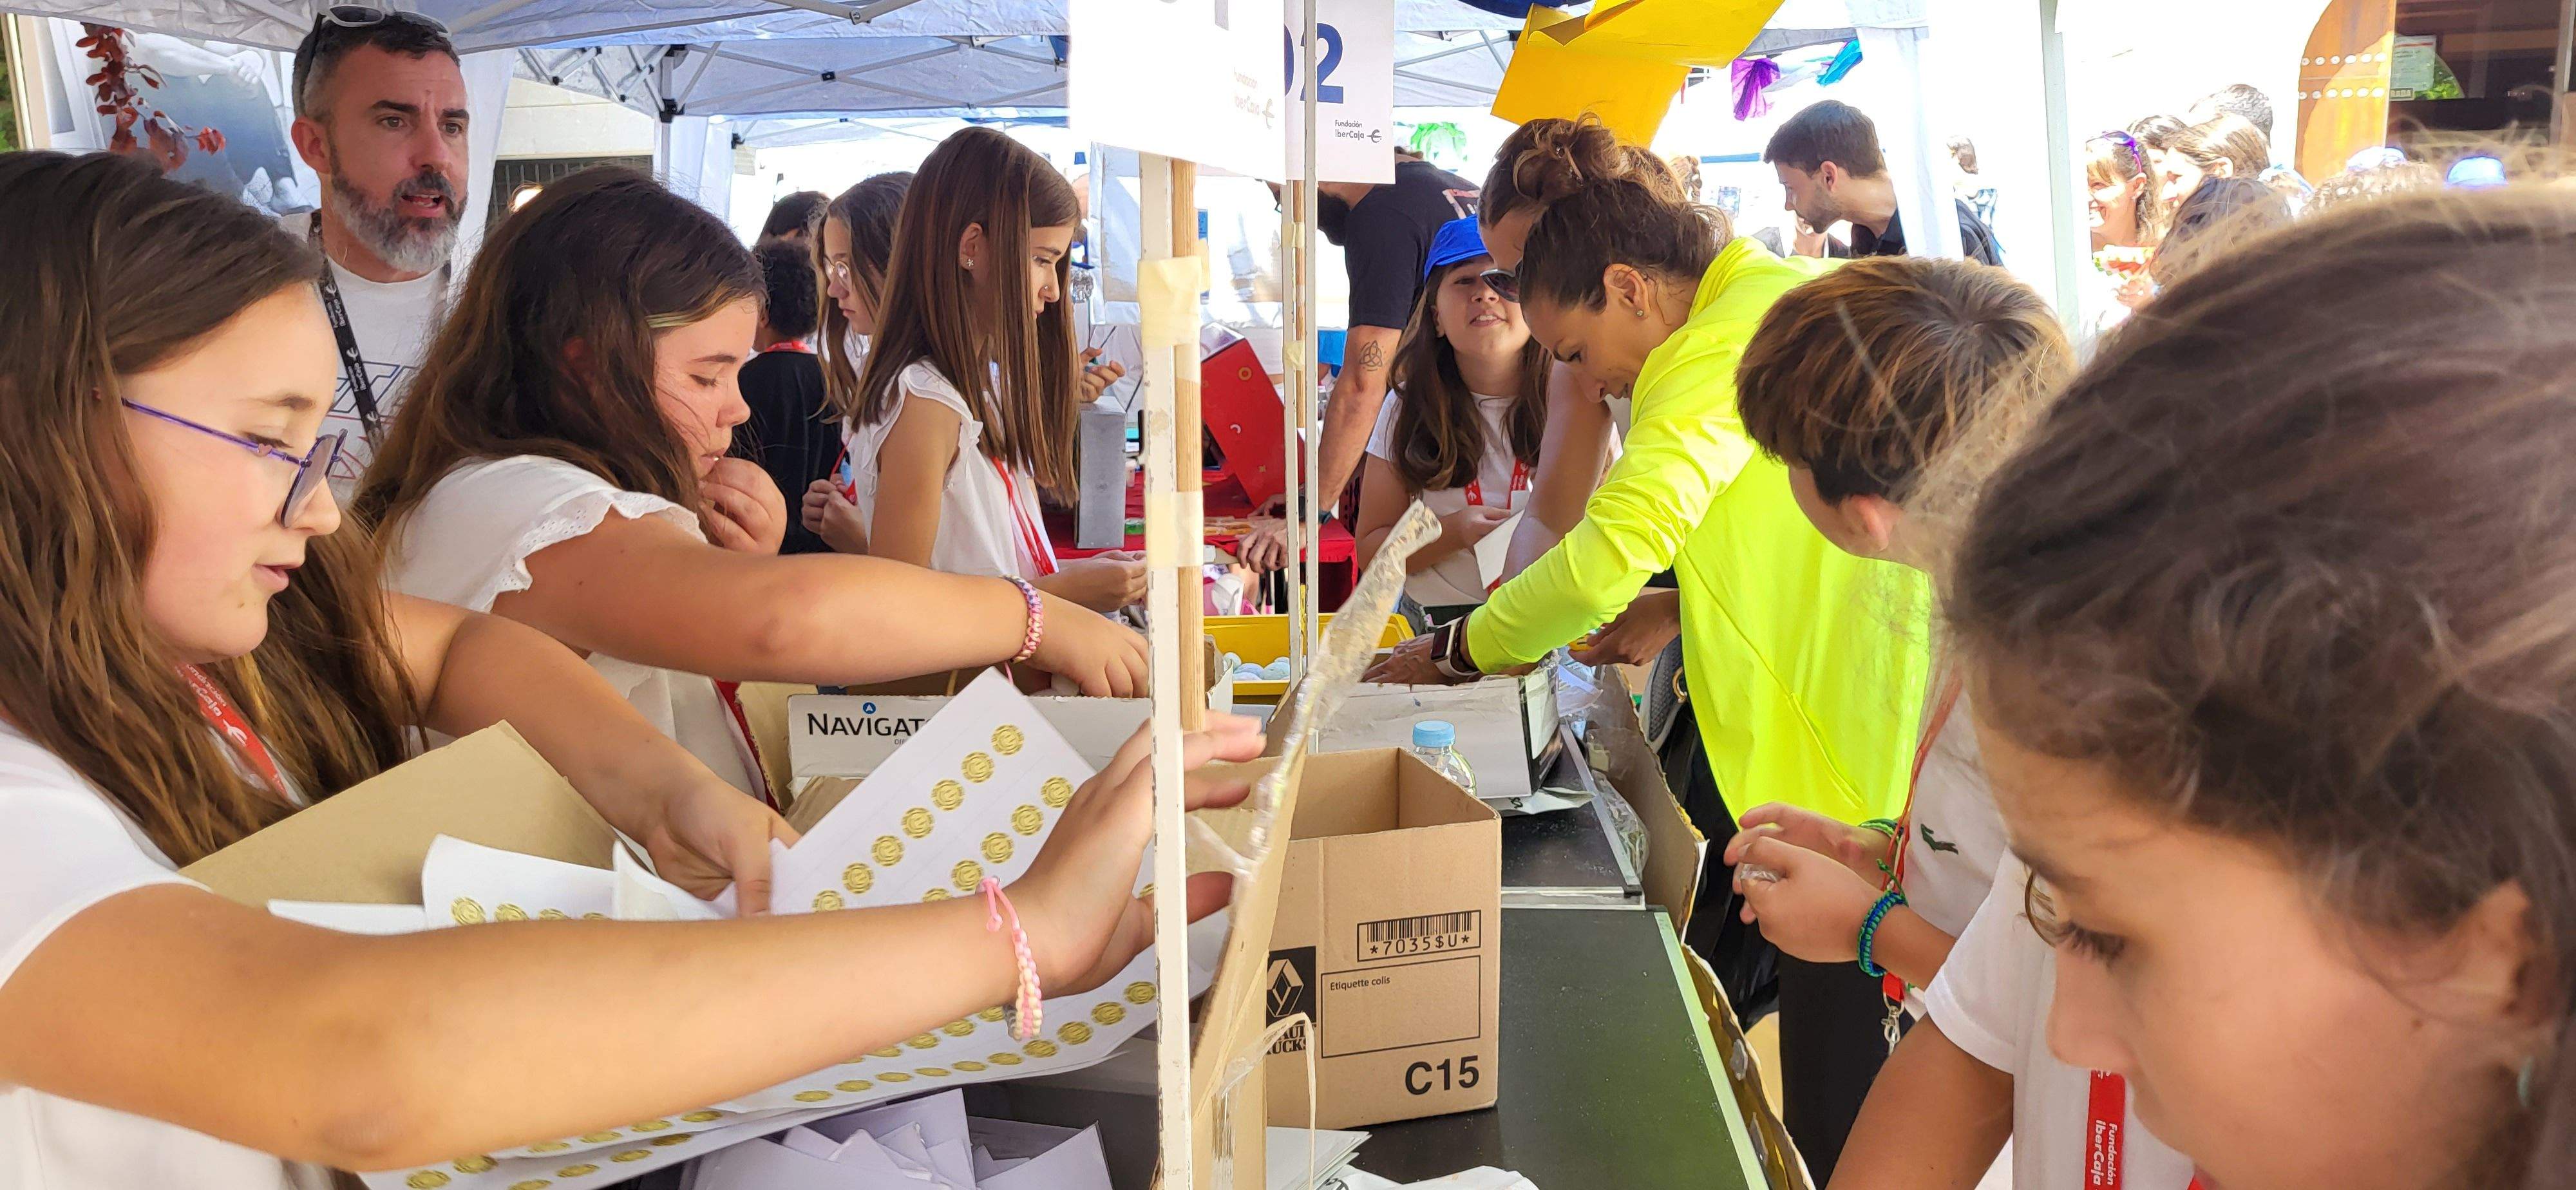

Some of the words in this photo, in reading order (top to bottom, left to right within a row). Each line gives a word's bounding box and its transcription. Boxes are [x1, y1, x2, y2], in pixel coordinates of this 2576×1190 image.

[1284, 23, 1343, 104] 2
[1335, 119, 1363, 128] Fundación
[808, 713, 932, 736] NAVIGAT
[1330, 979, 1370, 991] Etiquette
[1371, 976, 1390, 986] colis
[1405, 1055, 1479, 1095] C15
[2107, 1123, 2117, 1185] Fundación
